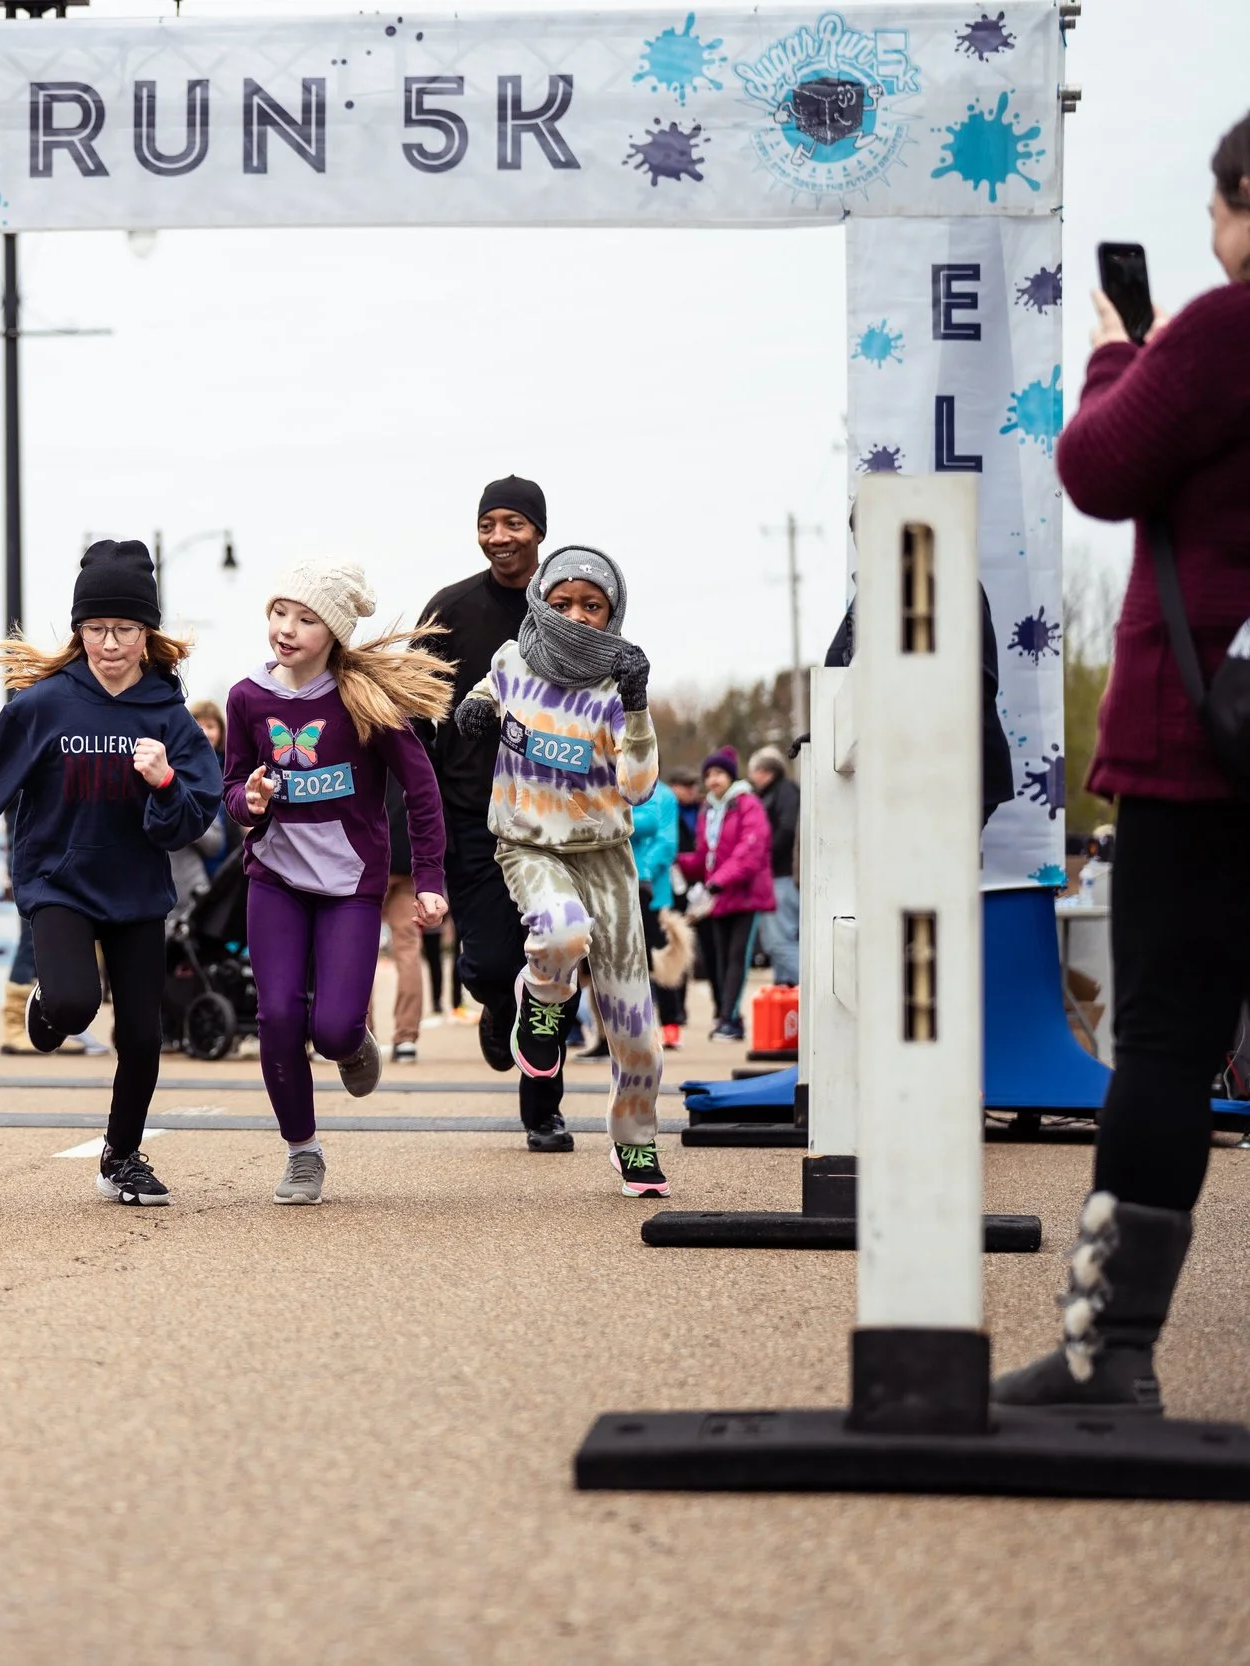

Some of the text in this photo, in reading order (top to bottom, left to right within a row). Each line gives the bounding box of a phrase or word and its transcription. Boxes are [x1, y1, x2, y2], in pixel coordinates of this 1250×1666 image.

[734, 25, 817, 107] Sugar
[816, 11, 875, 70] Run
[29, 78, 327, 177] RUN
[402, 75, 582, 173] 5K
[531, 737, 584, 765] 2022
[293, 770, 346, 796] 2022
